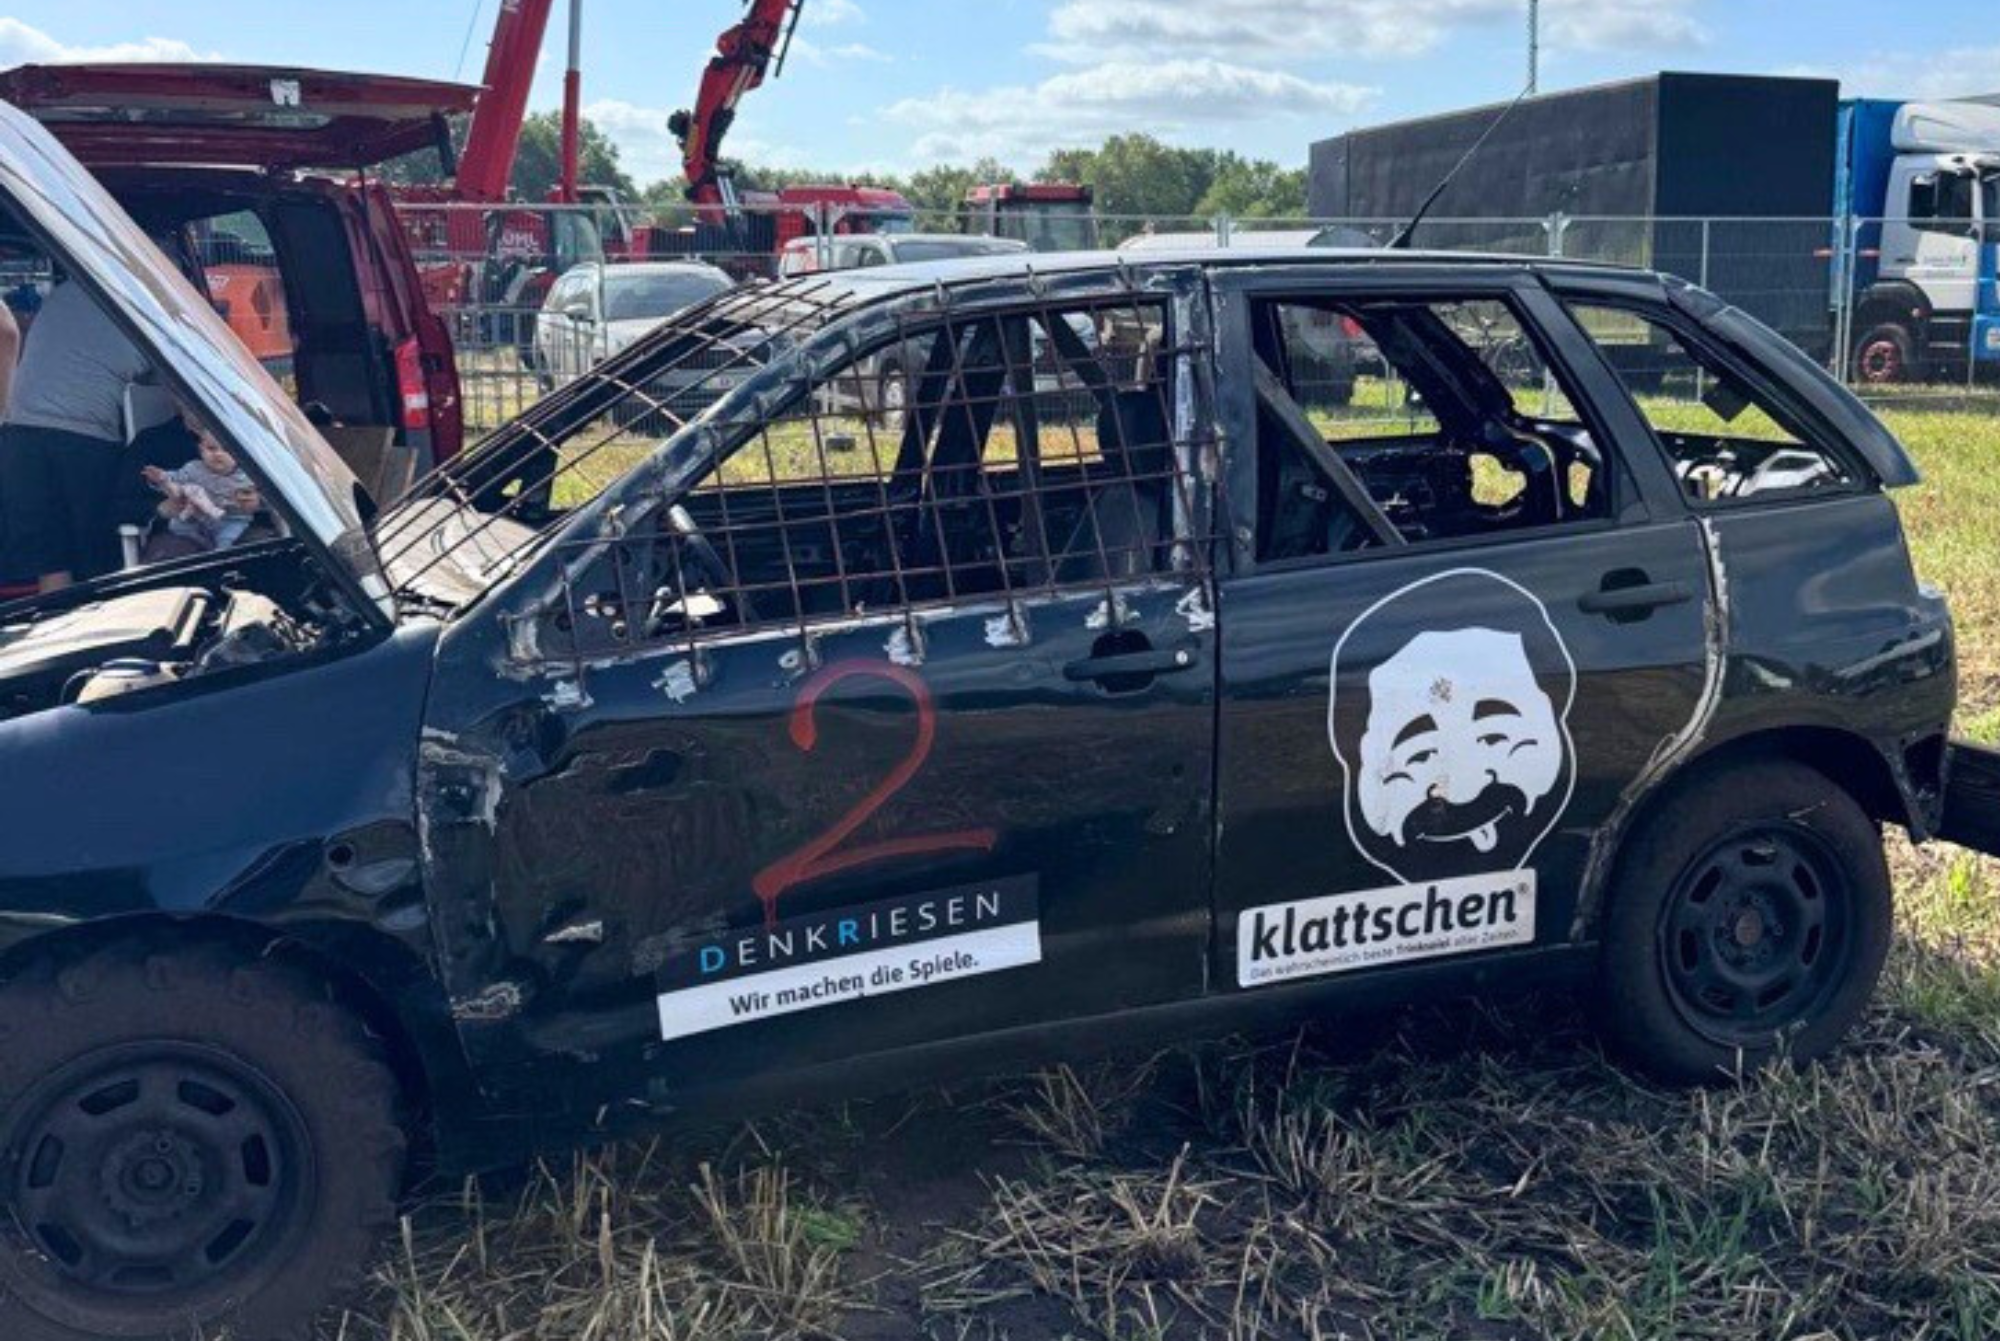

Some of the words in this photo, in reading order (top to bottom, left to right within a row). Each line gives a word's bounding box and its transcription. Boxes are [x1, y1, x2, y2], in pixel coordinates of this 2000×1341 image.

[753, 658, 997, 905] 2
[700, 891, 1001, 973] DENKRIESEN
[728, 991, 769, 1016] Wir
[776, 971, 865, 1006] machen
[871, 964, 904, 988] die
[909, 949, 979, 981] Spiele.
